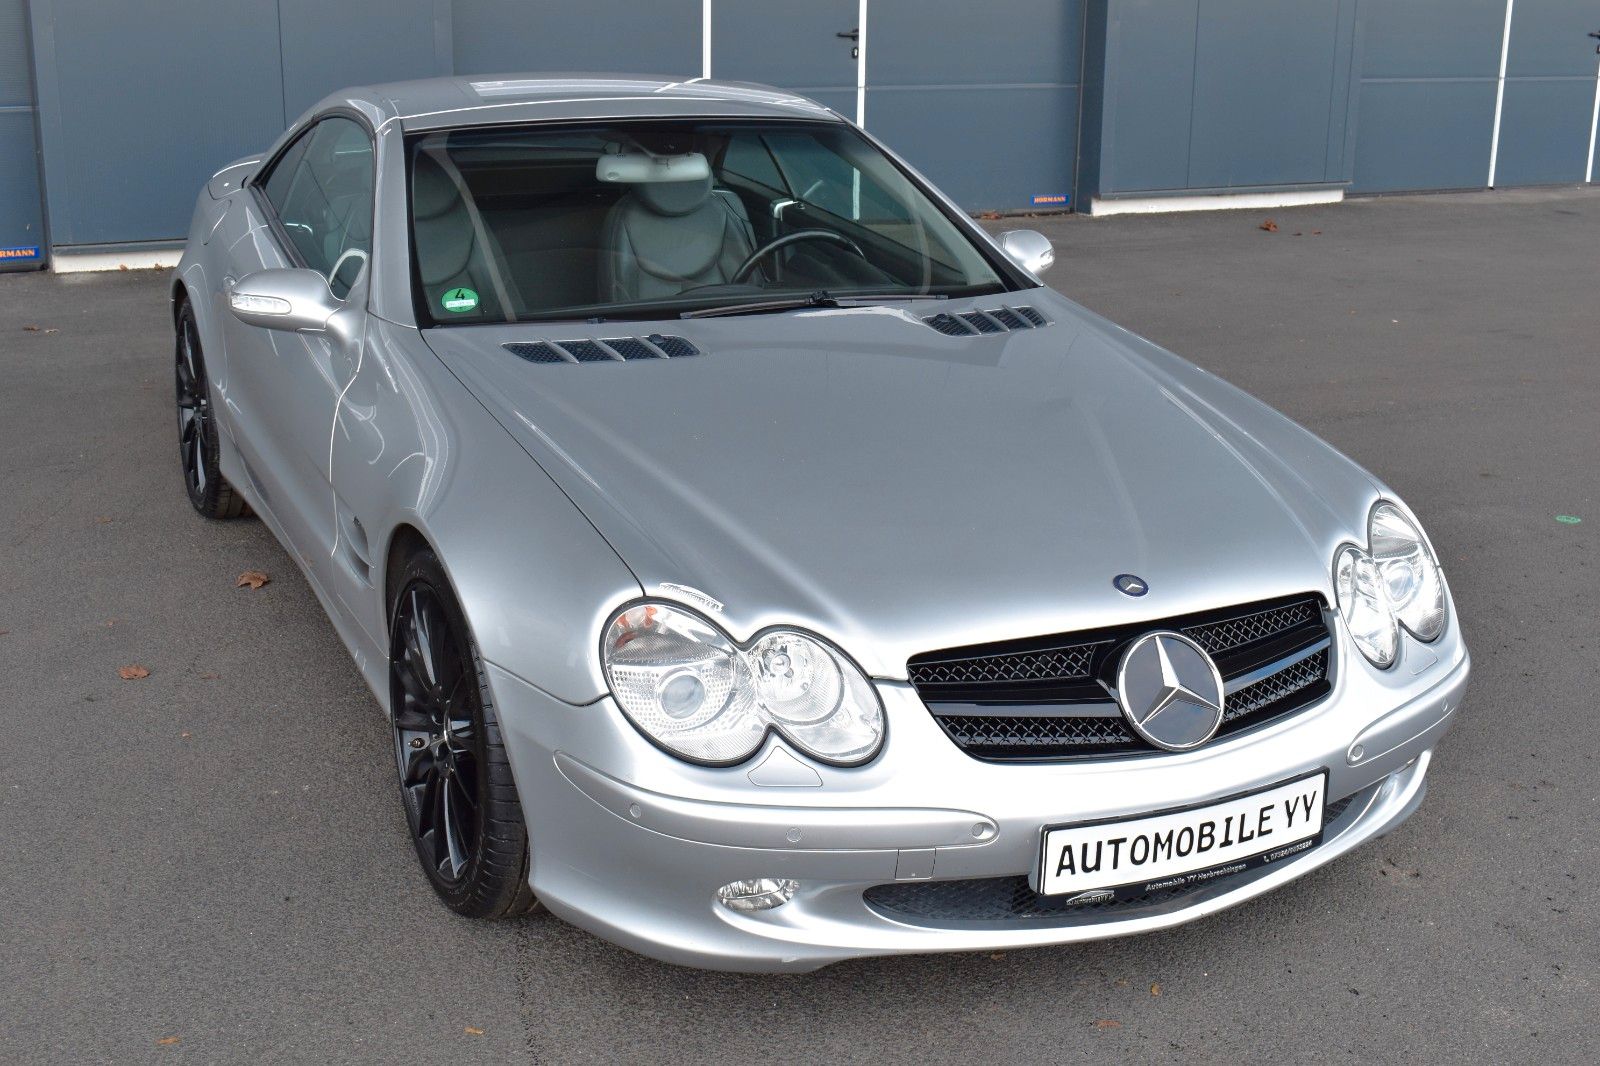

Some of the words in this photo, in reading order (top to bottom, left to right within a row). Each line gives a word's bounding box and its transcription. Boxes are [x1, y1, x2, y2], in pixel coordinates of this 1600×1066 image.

[455, 289, 465, 300] 4
[1055, 804, 1275, 877] AUTOMOBILE
[1284, 790, 1317, 828] YY
[1145, 877, 1186, 892] Automobile
